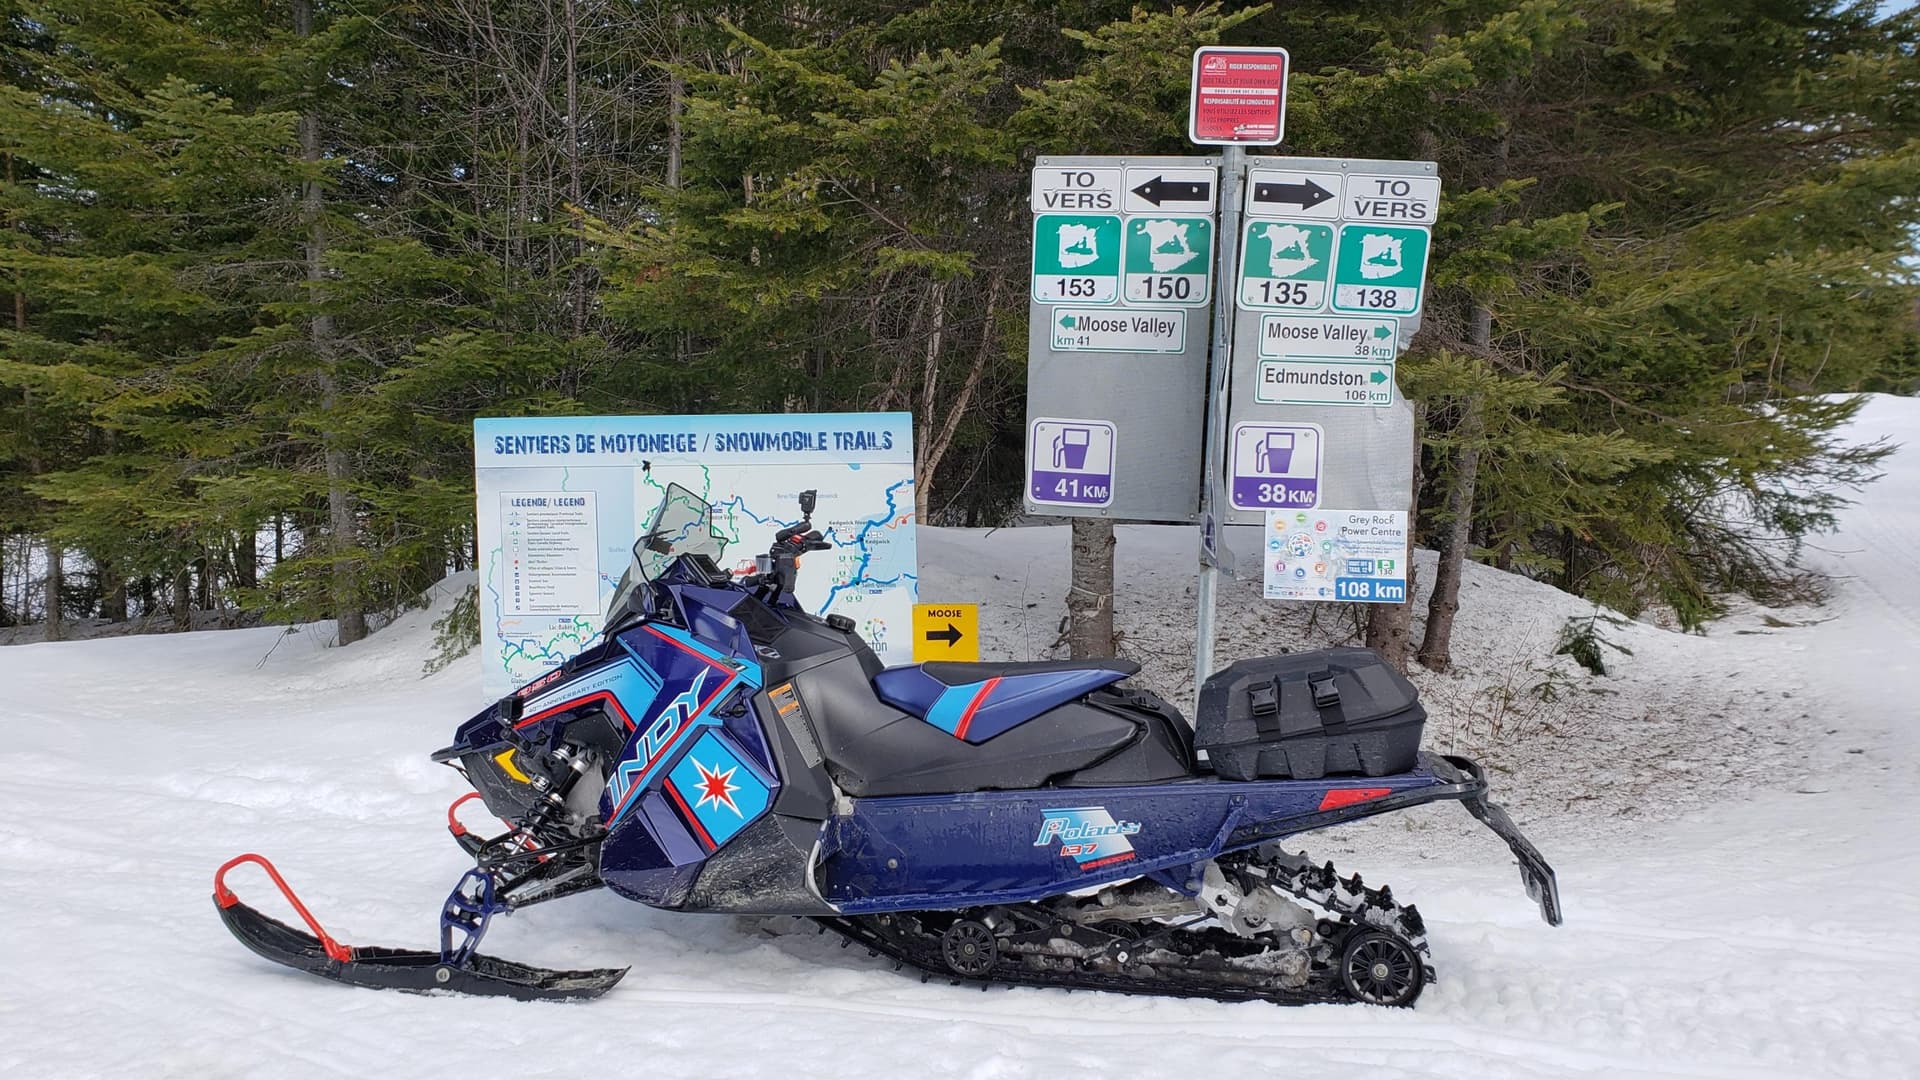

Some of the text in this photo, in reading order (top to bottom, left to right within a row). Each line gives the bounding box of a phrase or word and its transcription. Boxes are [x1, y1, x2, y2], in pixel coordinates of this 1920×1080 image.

[1061, 172, 1095, 188] TO
[1374, 180, 1410, 196] TO
[1043, 193, 1112, 208] VERS
[1354, 201, 1426, 219] VERS
[1057, 278, 1096, 297] 153
[1142, 276, 1190, 300] 150
[1260, 280, 1308, 305] 135
[1356, 288, 1397, 308] 138
[1078, 316, 1176, 338] Moose Valley
[1268, 322, 1368, 344] Moose Valley
[1057, 335, 1090, 346] km 41
[1354, 345, 1391, 357] 38 km
[1265, 368, 1363, 386] Edmundston
[1345, 390, 1388, 401] 106 km
[494, 430, 893, 454] SENTIERS DE MOTONEIGE / SNOWMOBILE TRAILS
[1054, 478, 1106, 498] 41 KM
[1258, 484, 1313, 503] 38 KM
[554, 497, 585, 506] LEGEND
[1349, 515, 1394, 526] Grey Rock
[1341, 526, 1401, 536] Power Centre
[1338, 582, 1402, 598] 108 km
[928, 610, 962, 618] MOOSE
[542, 686, 590, 708] ANNIVERSARY
[592, 674, 623, 688] EDITION
[606, 665, 711, 811] INDY
[1033, 817, 1142, 846] Polaris
[1060, 842, 1098, 856] 137
